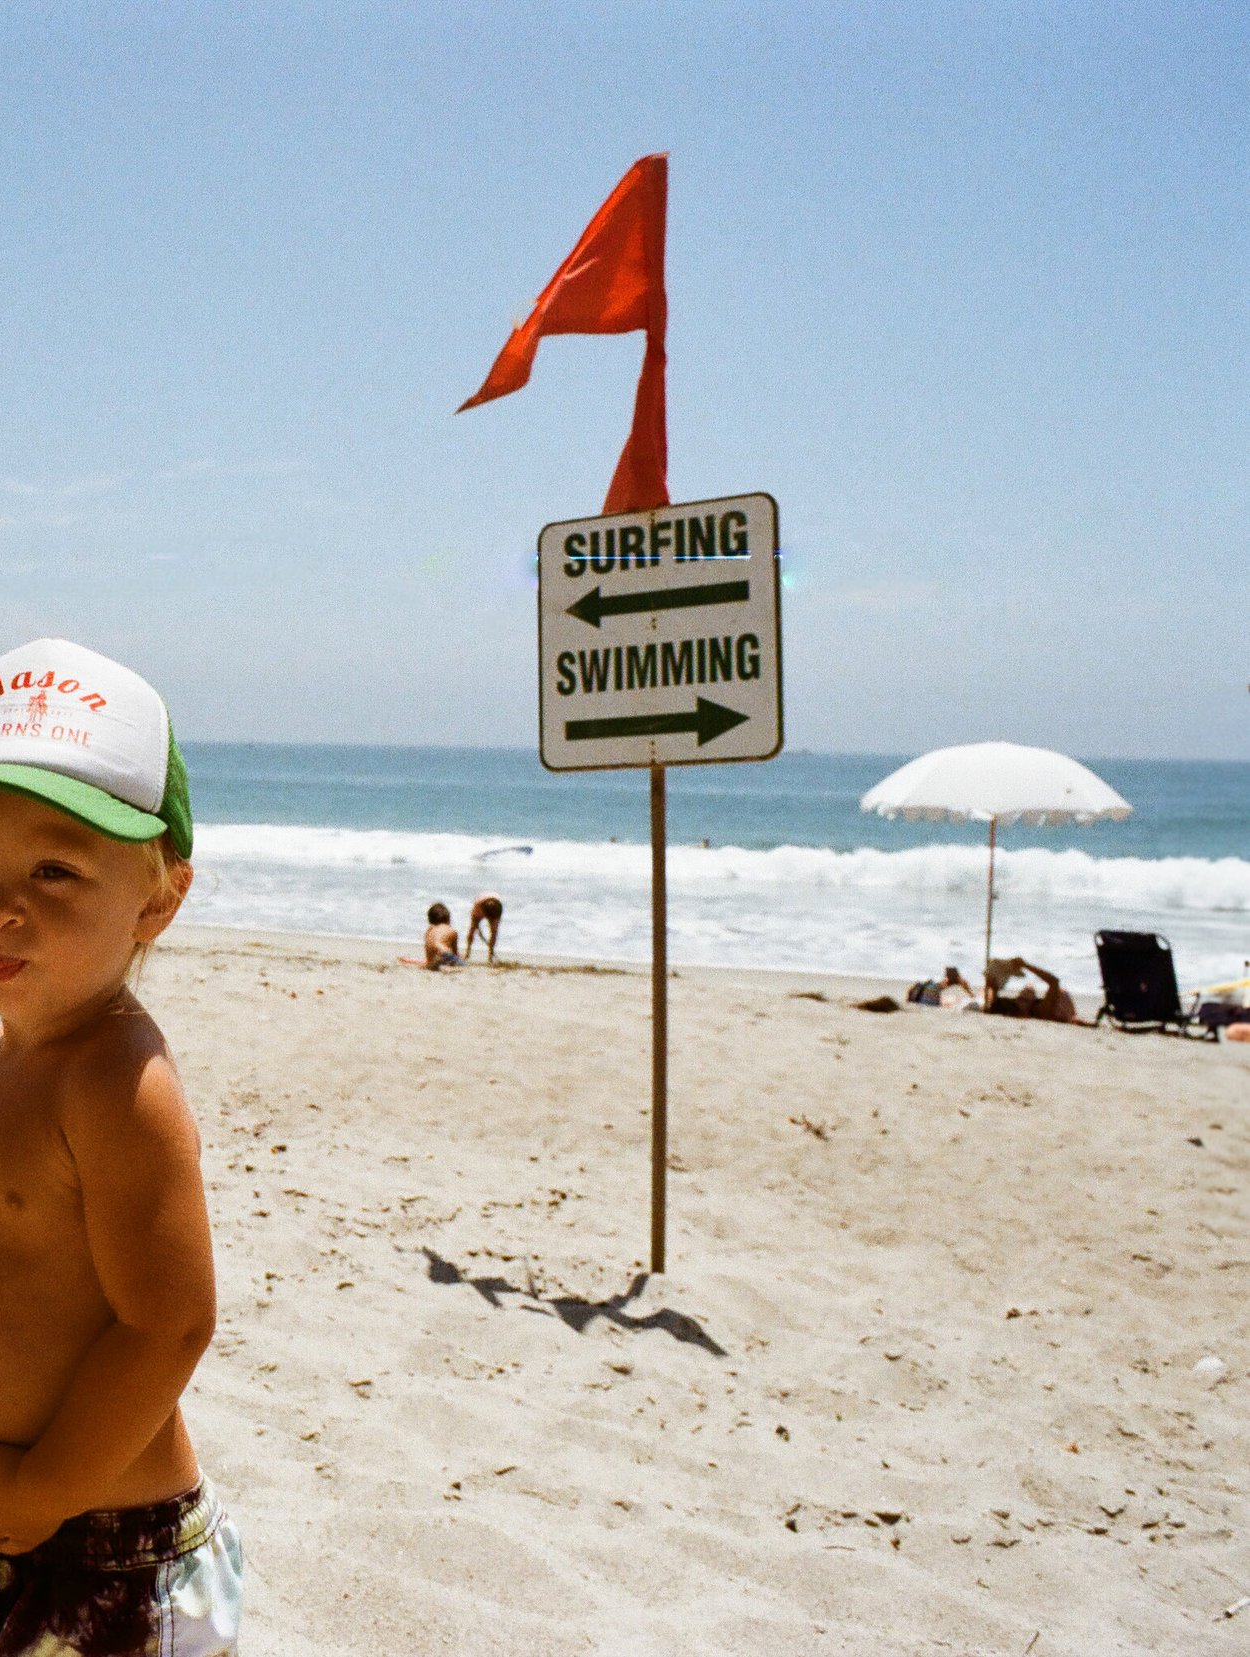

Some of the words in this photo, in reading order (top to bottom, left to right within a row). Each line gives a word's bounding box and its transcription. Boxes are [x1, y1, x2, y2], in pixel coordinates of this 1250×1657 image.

[563, 511, 748, 577] SURFING
[556, 633, 761, 696] SWIMMING
[51, 725, 93, 748] ONE
